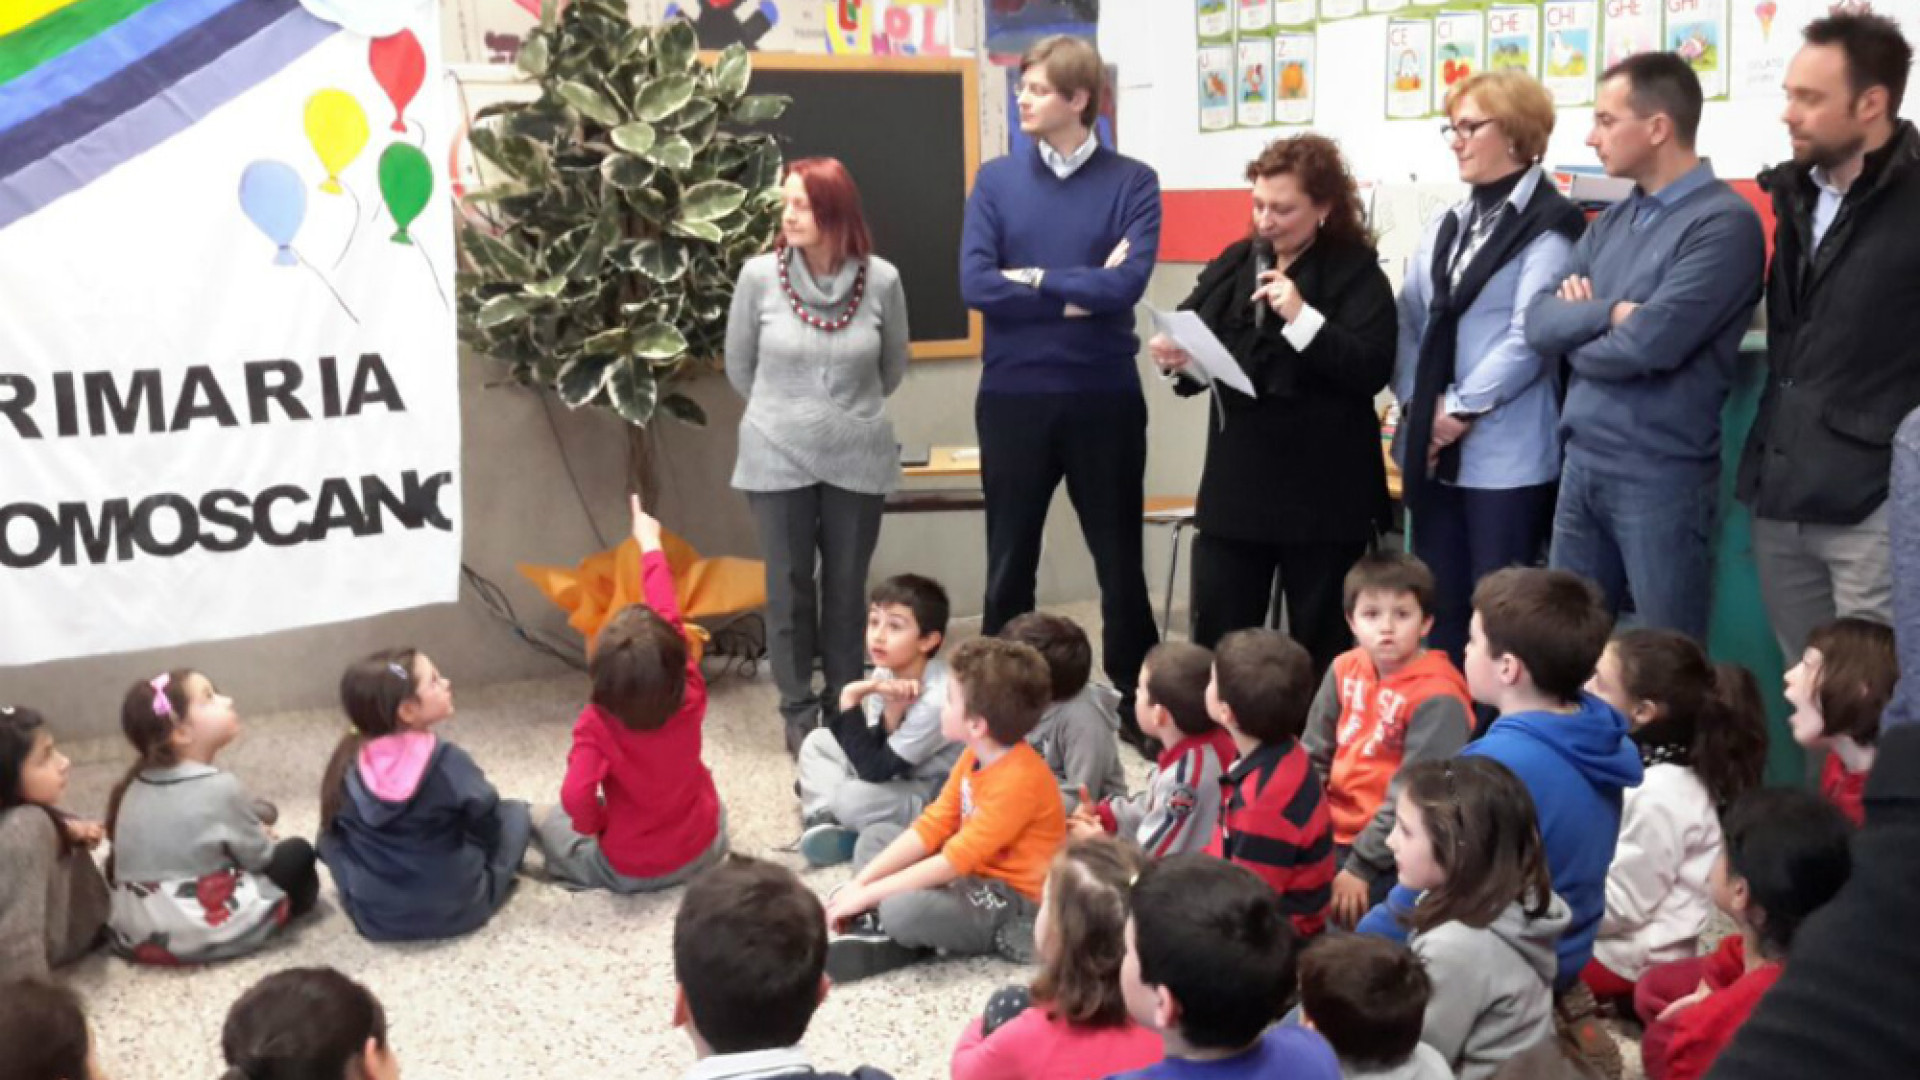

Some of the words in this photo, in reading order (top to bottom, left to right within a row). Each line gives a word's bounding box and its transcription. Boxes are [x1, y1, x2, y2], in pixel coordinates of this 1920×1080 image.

[1606, 0, 1641, 18] GHE
[1668, 0, 1700, 13] GHI
[1490, 13, 1519, 34] CHE
[1547, 6, 1576, 27] CHI
[1390, 28, 1408, 47] CE
[1438, 20, 1452, 39] CI
